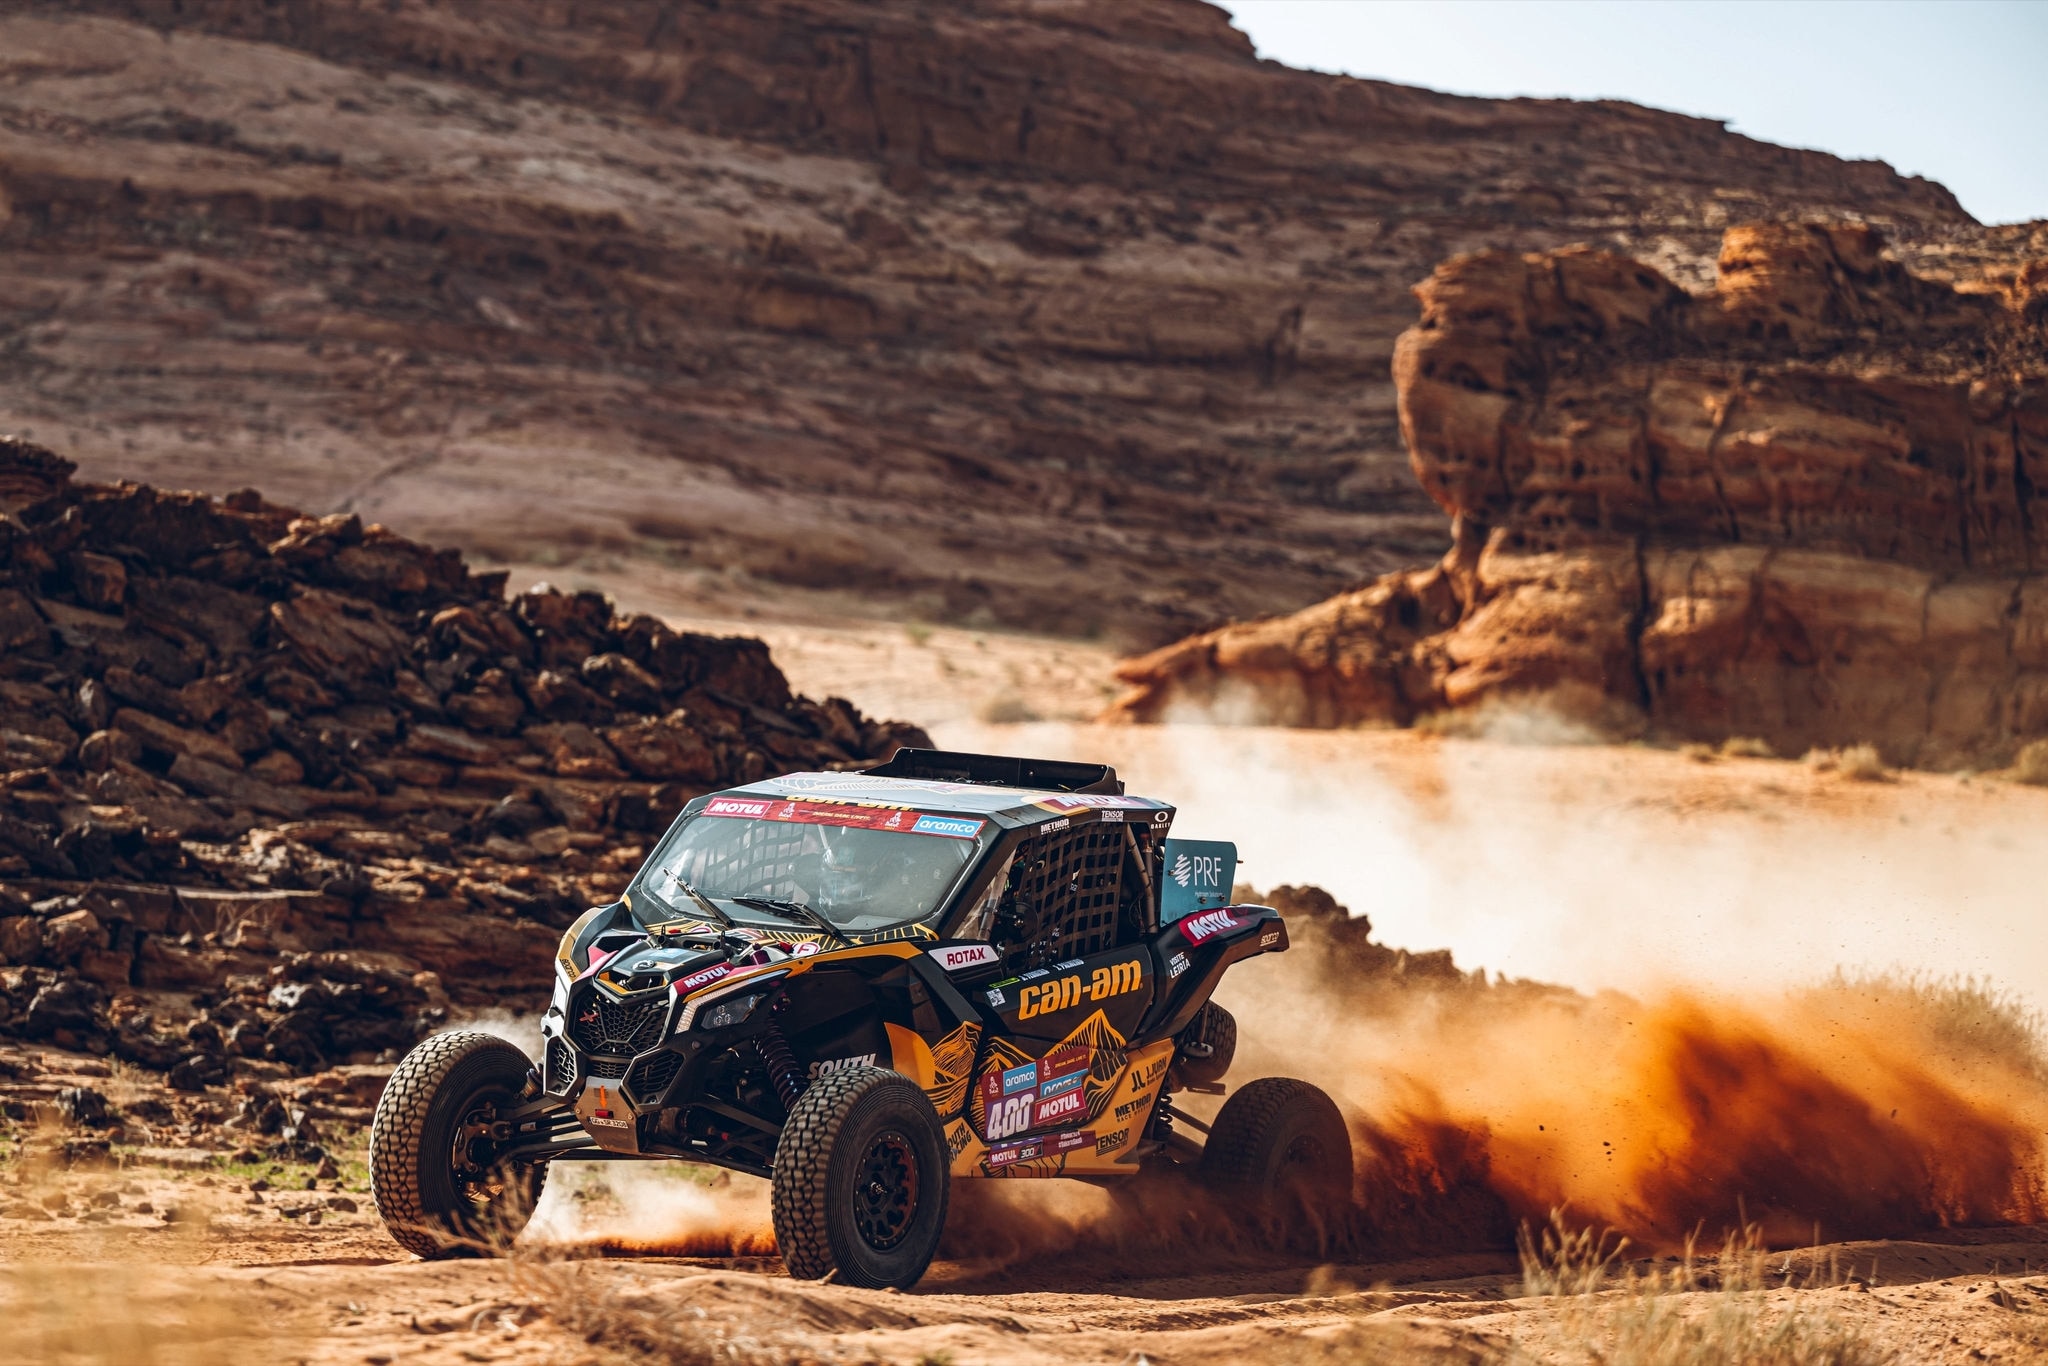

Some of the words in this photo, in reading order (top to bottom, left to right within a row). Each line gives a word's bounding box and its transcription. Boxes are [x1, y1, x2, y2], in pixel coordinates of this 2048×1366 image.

[709, 802, 766, 815] MOTUL
[1101, 810, 1124, 820] TENSOR
[919, 820, 975, 833] aramco
[1040, 818, 1070, 833] METHOD
[1193, 855, 1222, 887] PRF
[1187, 909, 1239, 941] MOTUL
[946, 947, 985, 966] ROTAX
[1168, 951, 1185, 967] VISITE
[683, 966, 730, 989] MOTUL
[1169, 958, 1192, 979] LEIRIA
[1018, 959, 1142, 1021] can-am
[1005, 1071, 1035, 1087] aramco
[987, 1093, 1035, 1140] 400
[1038, 1093, 1080, 1120] MOTUL
[1096, 1127, 1130, 1150] TENSOR
[991, 1149, 1017, 1163] MOTUL
[1020, 1147, 1035, 1159] 300
